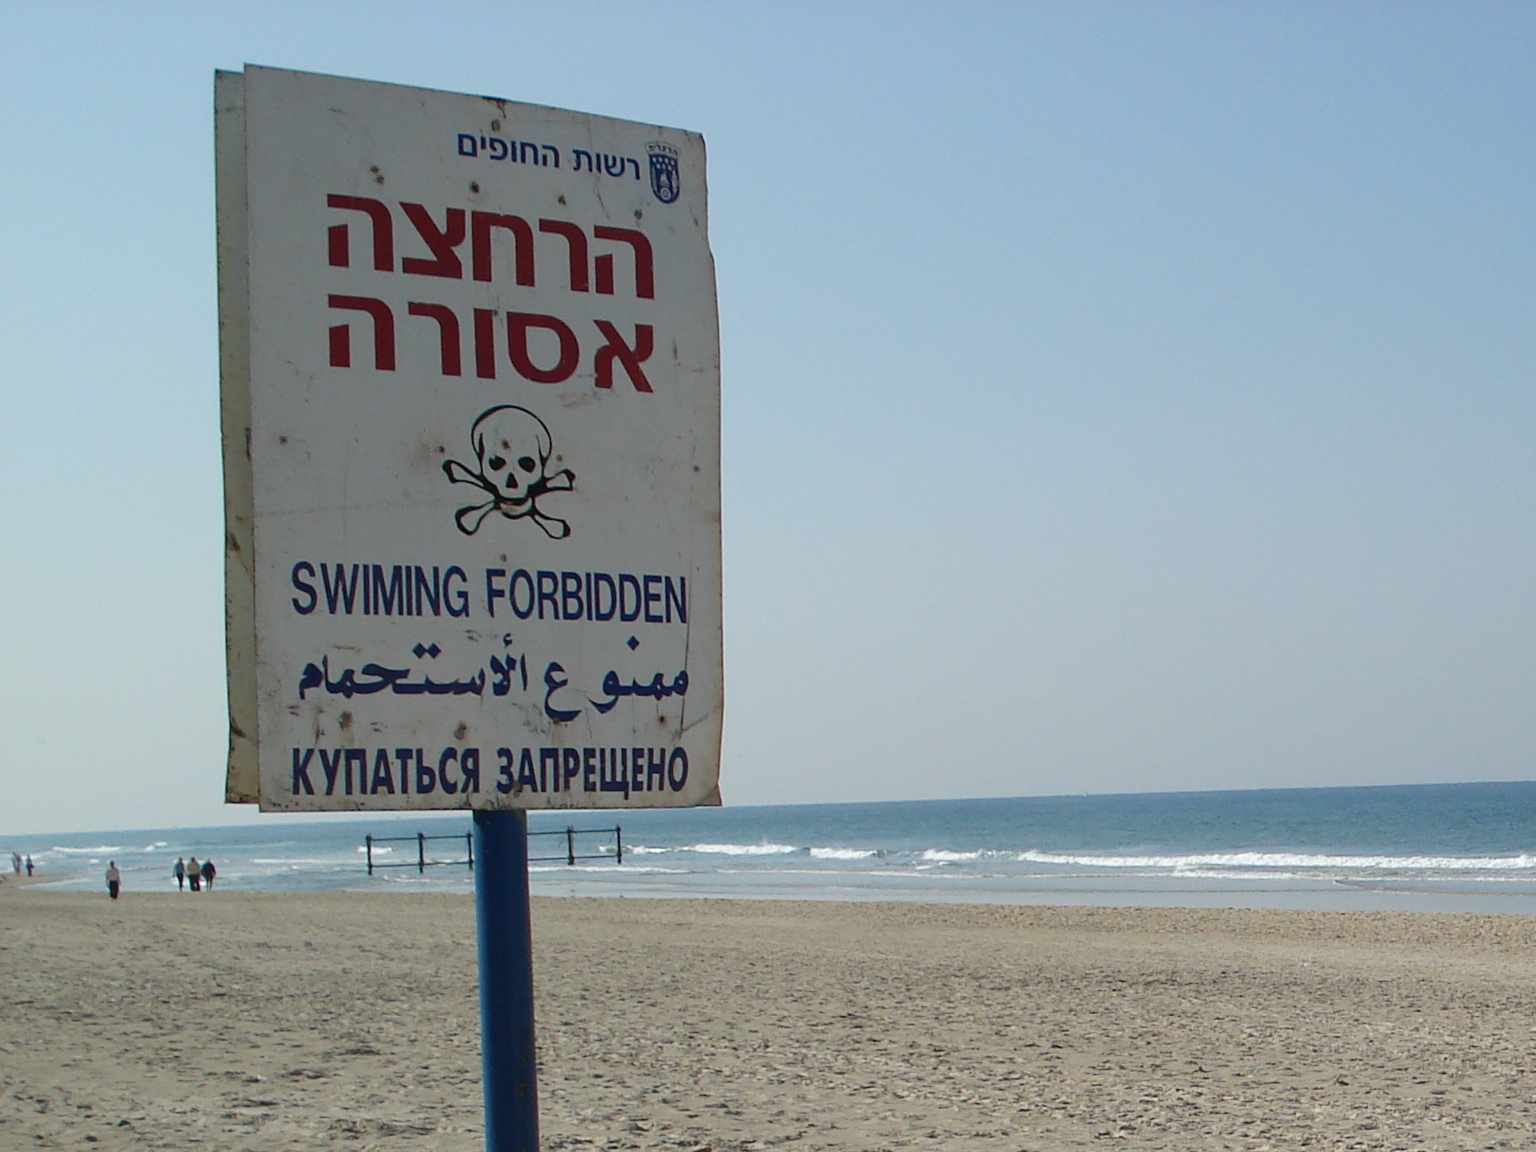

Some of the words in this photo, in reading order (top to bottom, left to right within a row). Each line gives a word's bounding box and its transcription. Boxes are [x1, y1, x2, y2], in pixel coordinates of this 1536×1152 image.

[457, 132, 560, 169] החופים
[572, 148, 641, 181] רשות
[326, 192, 656, 301] הרחצה
[327, 293, 655, 395] אסורה
[291, 561, 470, 618] SWIMING
[485, 568, 689, 624] FORBIDDEN
[543, 634, 690, 723] ممنوع
[291, 746, 481, 796] КУПАТЬСЯ
[496, 746, 689, 800] ЗАПРЕЩЕНО
